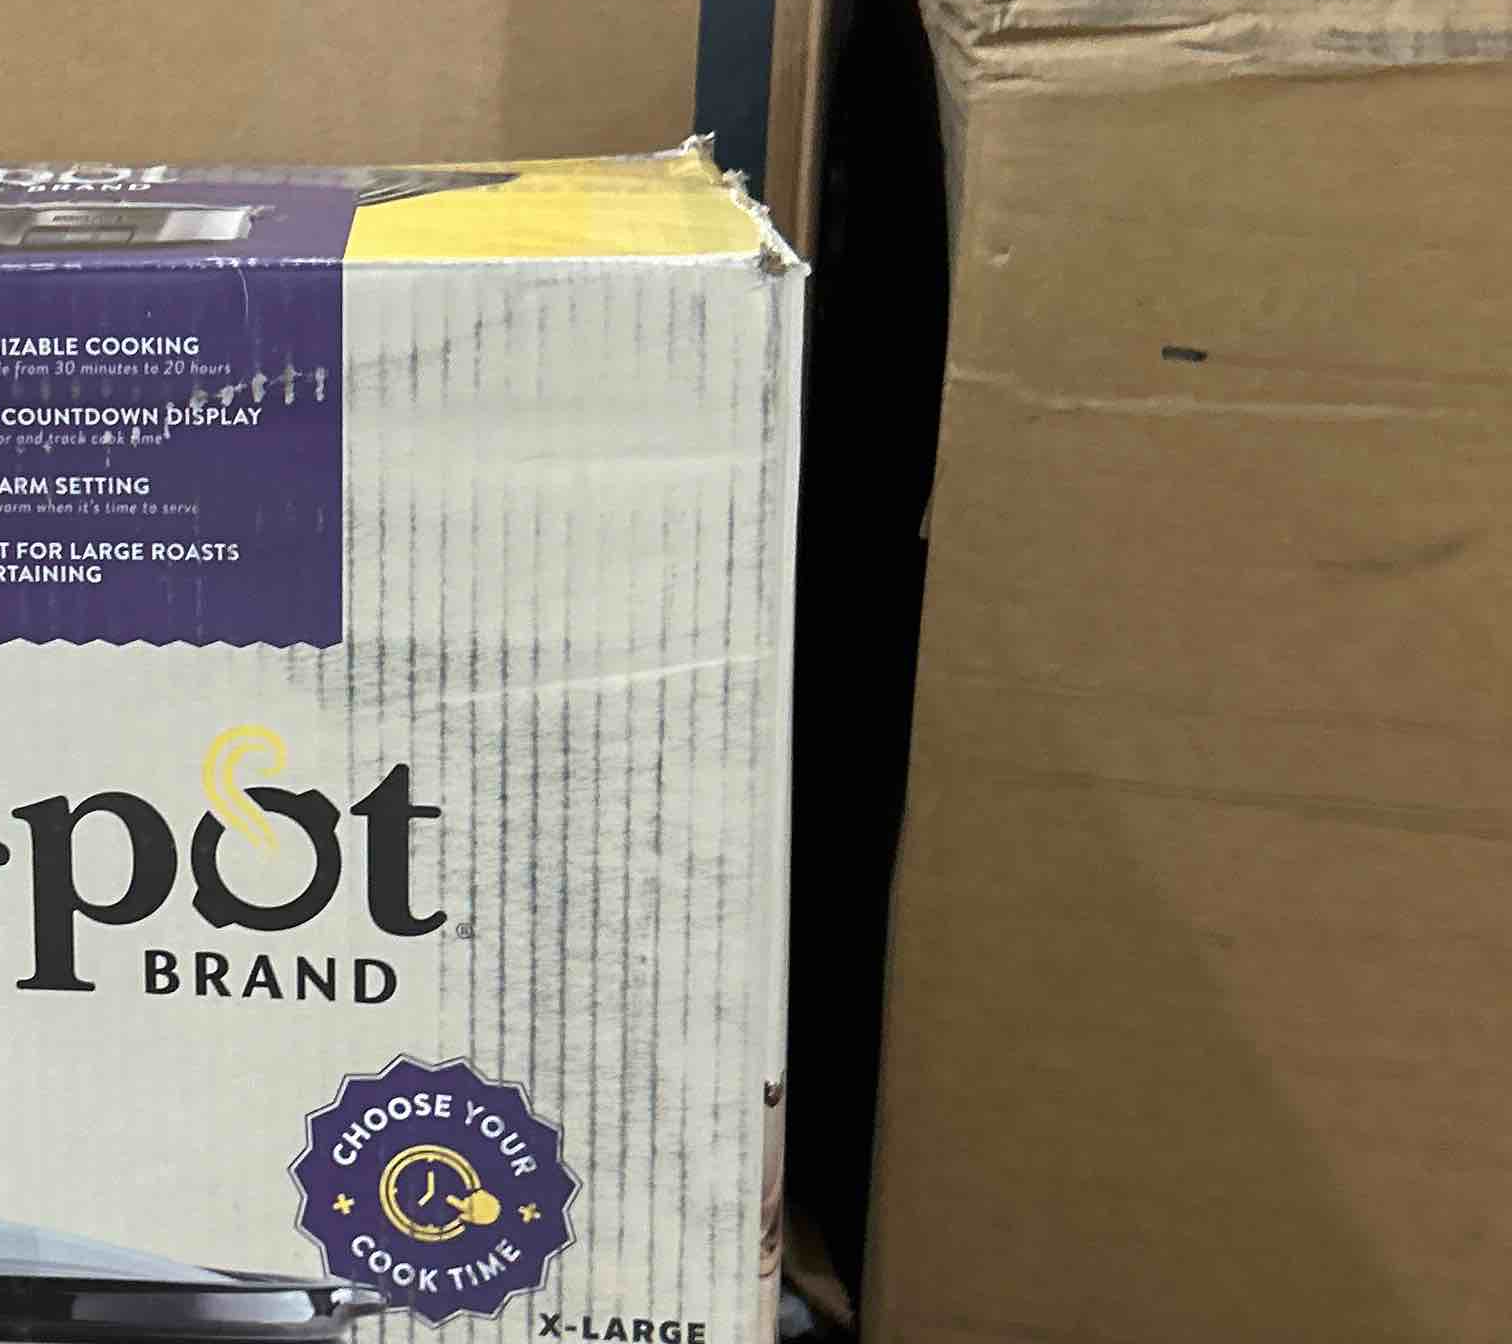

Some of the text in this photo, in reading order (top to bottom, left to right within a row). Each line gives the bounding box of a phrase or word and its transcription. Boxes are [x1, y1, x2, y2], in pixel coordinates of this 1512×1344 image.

[84, 335, 201, 357] COOKING
[12, 359, 50, 381] from
[54, 359, 76, 376] 30
[79, 360, 139, 376] minutes
[143, 361, 160, 376] to
[162, 359, 186, 376] 20
[189, 359, 232, 376] hours
[0, 406, 159, 426] COUNTDOWN
[165, 406, 263, 426] DISPLAY
[16, 430, 43, 447] and
[54, 476, 151, 495] SETTING
[36, 498, 74, 514] when
[105, 500, 138, 515] time
[142, 500, 158, 515] to
[162, 503, 201, 515] serve
[16, 541, 63, 561] FOR
[69, 542, 145, 561] LARGE
[151, 543, 240, 561] ROASTS
[142, 947, 400, 1006] BRAND
[331, 1092, 539, 1178] CHOOSE YOUR
[350, 1233, 522, 1293] COOK TIME
